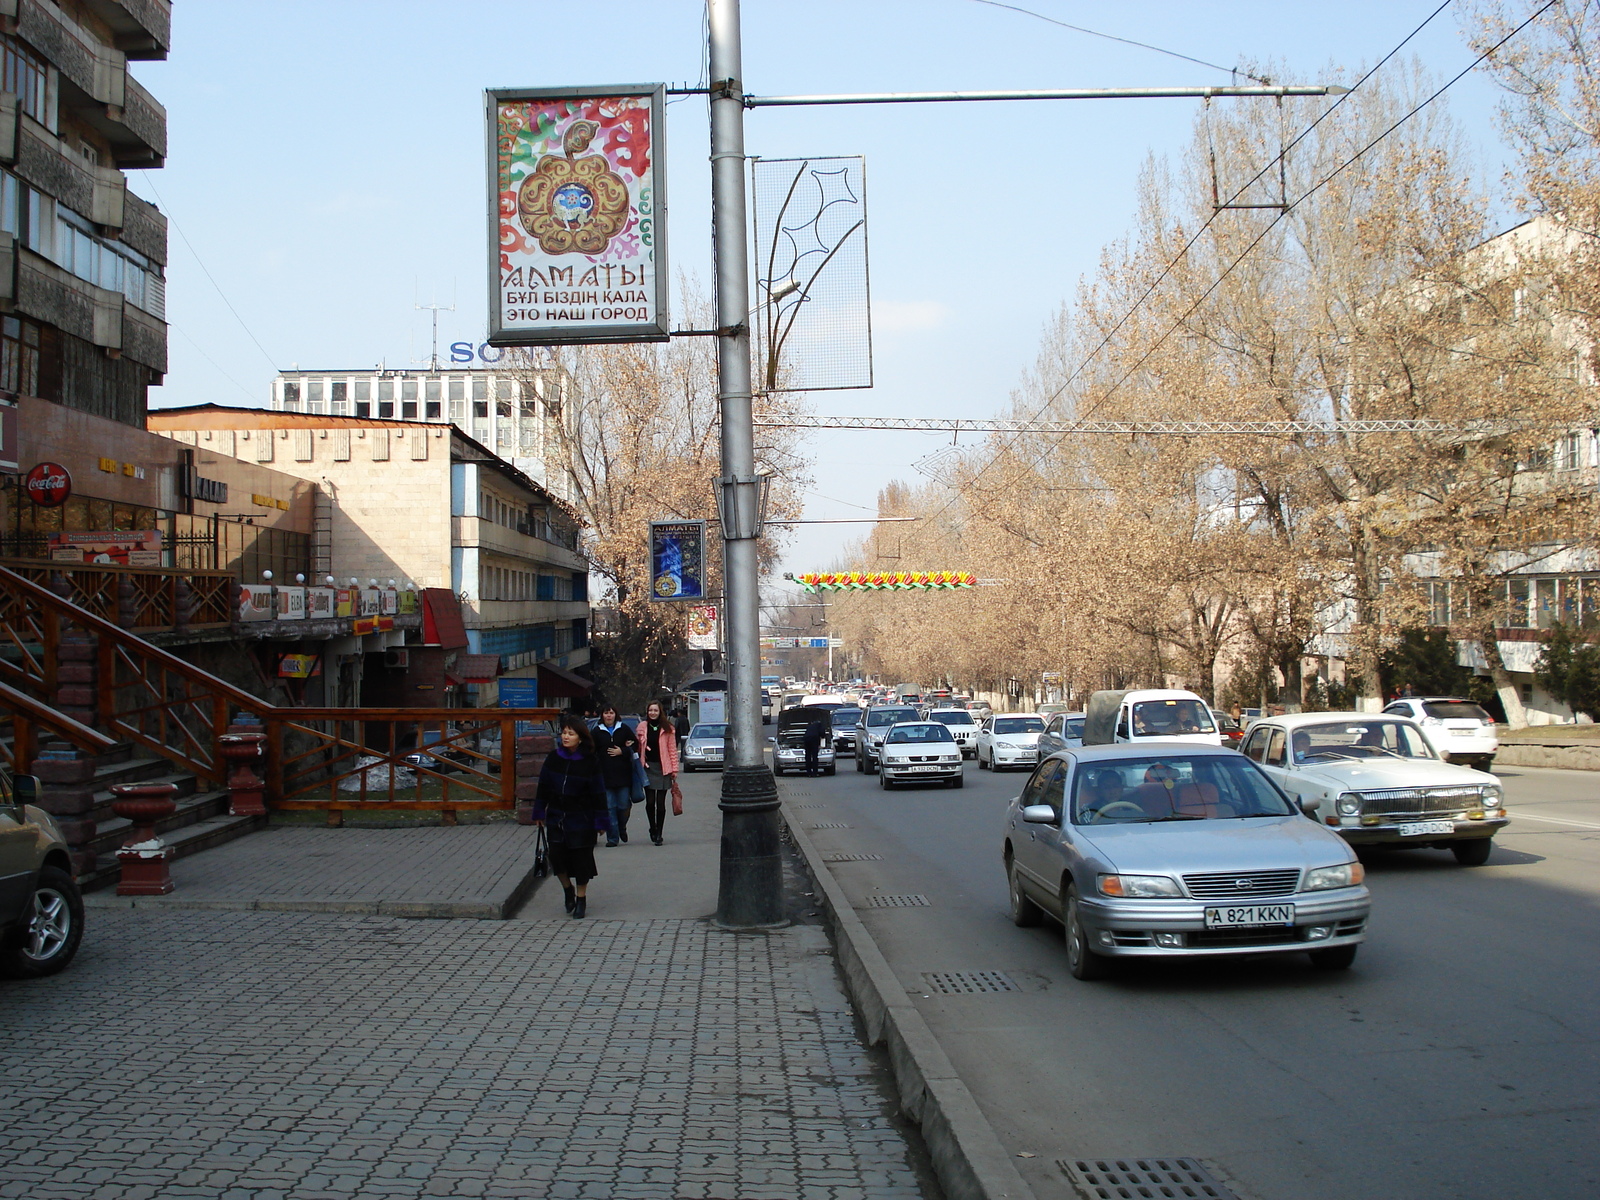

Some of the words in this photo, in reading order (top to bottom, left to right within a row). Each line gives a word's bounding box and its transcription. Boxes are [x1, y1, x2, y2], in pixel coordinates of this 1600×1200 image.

[503, 263, 645, 290] АЛМАТЫ
[507, 292, 538, 304] БҰЛ
[543, 291, 598, 306] БІЗДІҢ
[603, 290, 648, 305] ҚАЛА
[507, 308, 540, 321] ЭТО
[546, 308, 585, 321] НАШ
[592, 307, 648, 322] ГОРОД
[28, 475, 67, 491] Coca-Cola
[1212, 909, 1222, 924] A
[1227, 908, 1254, 923] 821
[1258, 906, 1289, 922] KKN
